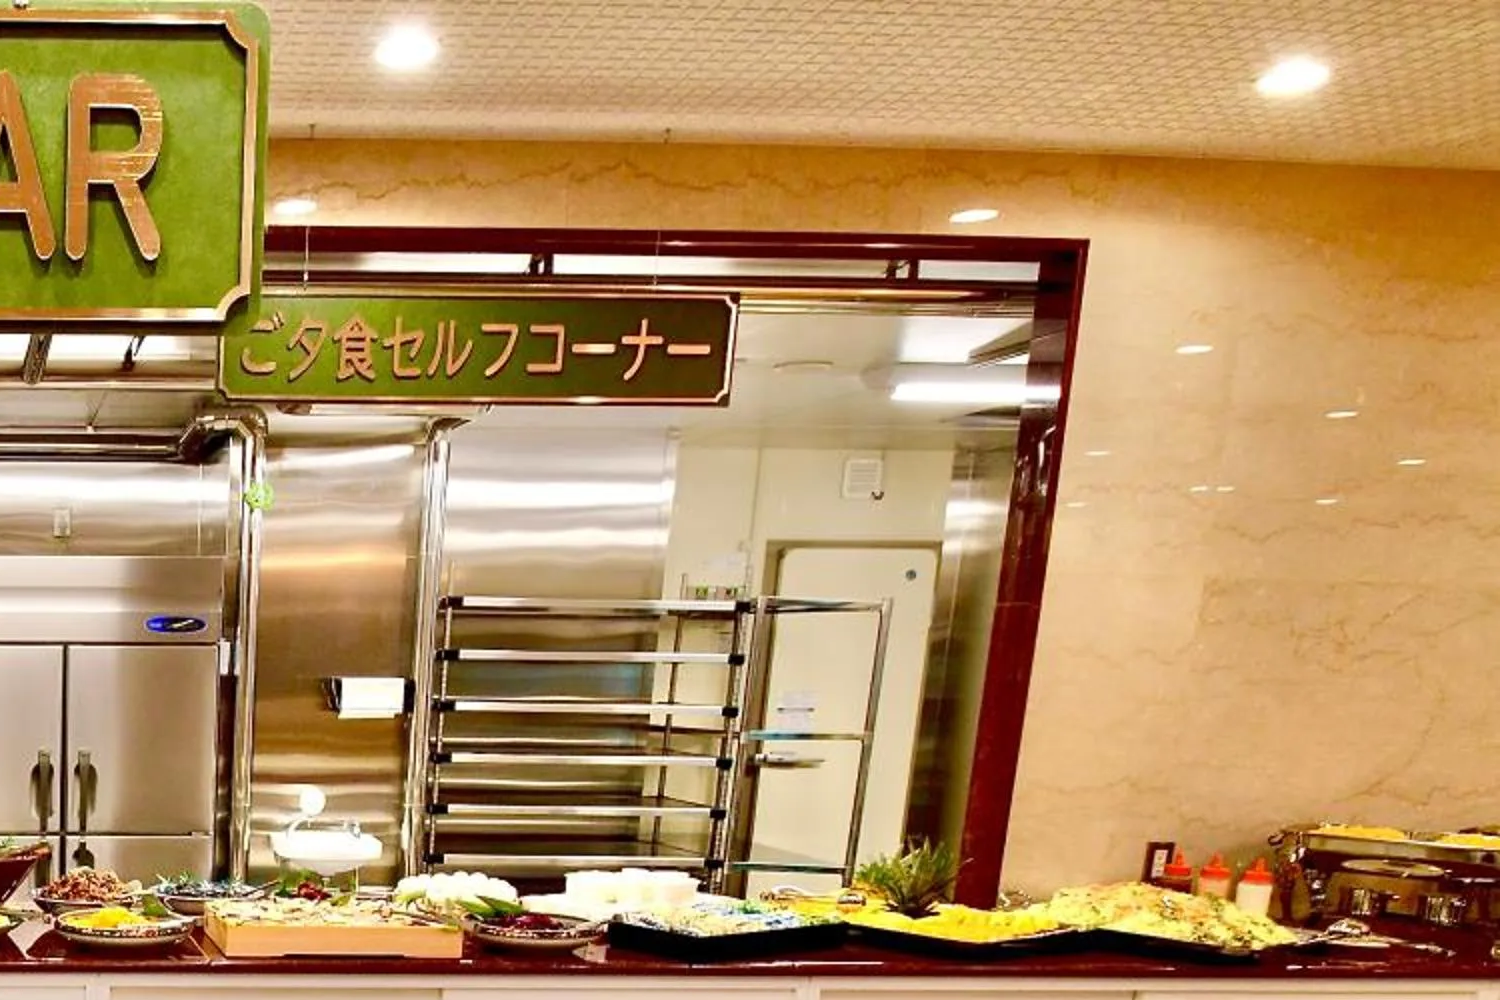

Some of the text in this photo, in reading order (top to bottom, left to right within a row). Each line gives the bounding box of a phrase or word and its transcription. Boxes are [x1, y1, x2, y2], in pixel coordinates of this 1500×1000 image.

[240, 312, 712, 381] ご夕食セルフコーナー
